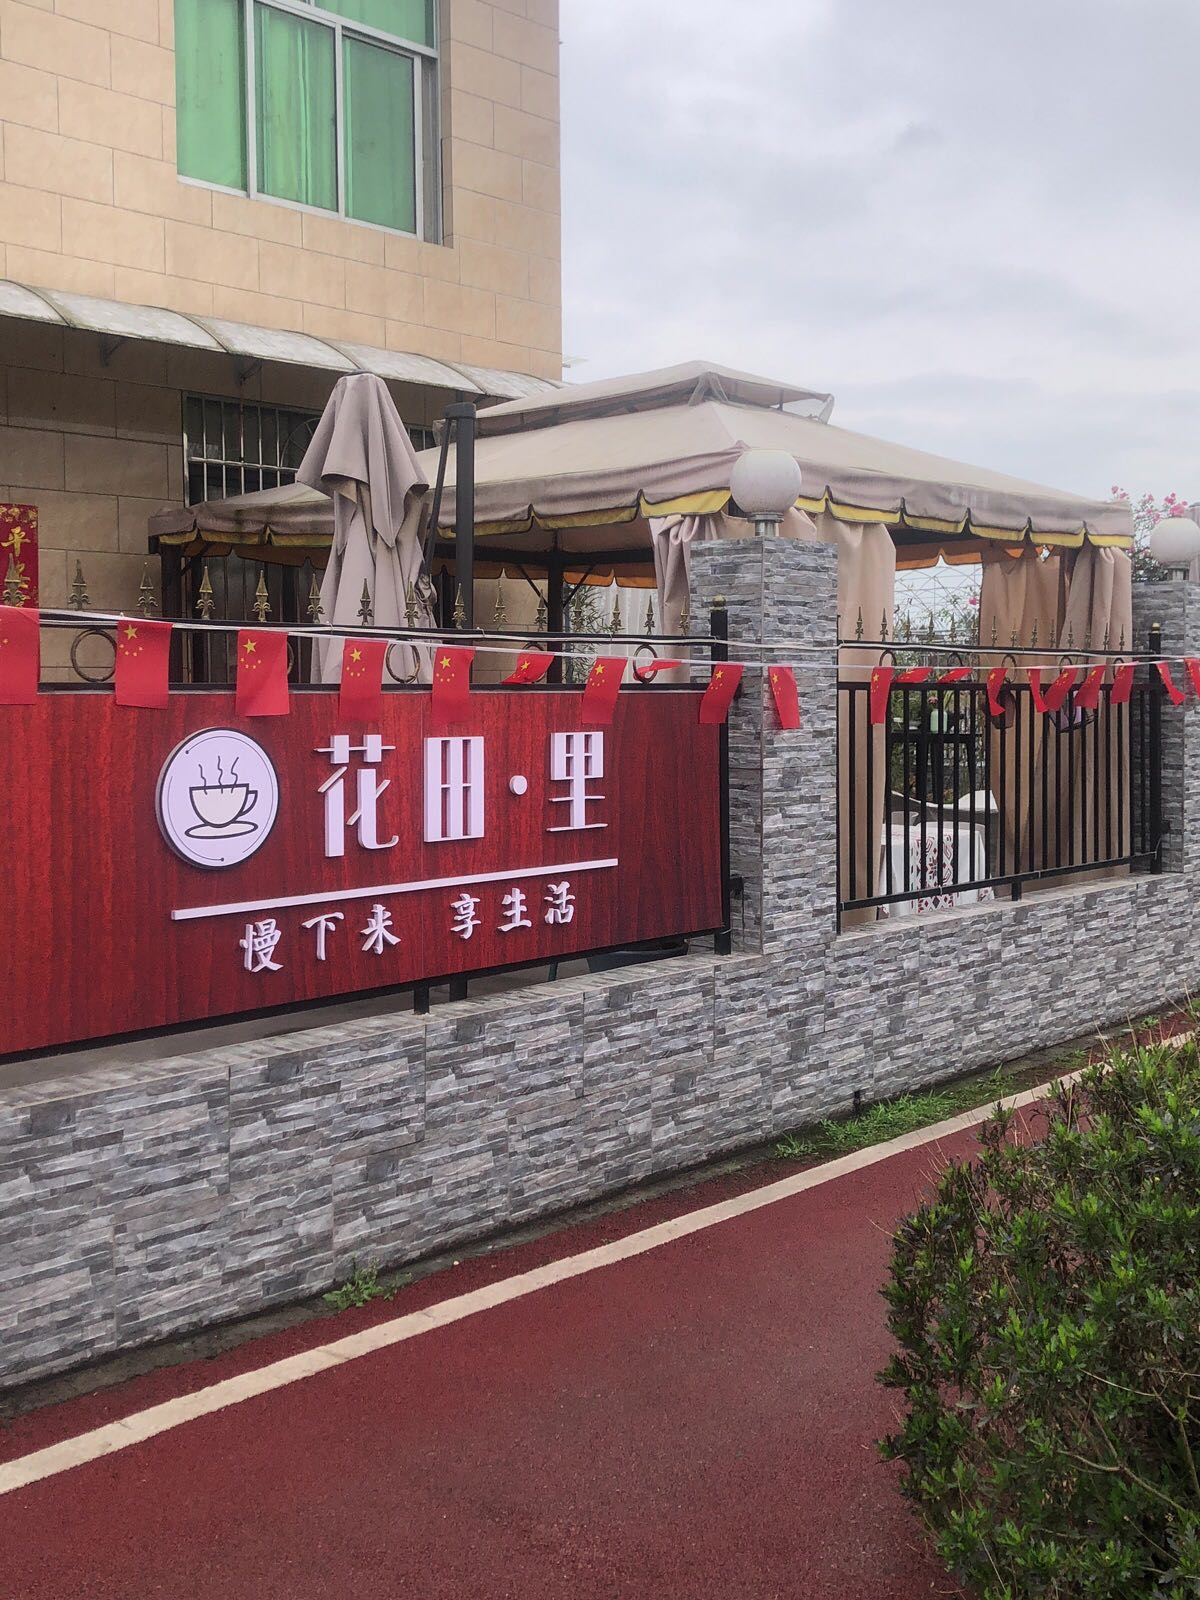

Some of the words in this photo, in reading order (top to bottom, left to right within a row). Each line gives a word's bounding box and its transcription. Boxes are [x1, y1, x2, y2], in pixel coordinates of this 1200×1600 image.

[239, 904, 401, 973] 慢下来
[450, 881, 576, 940] 享生活
